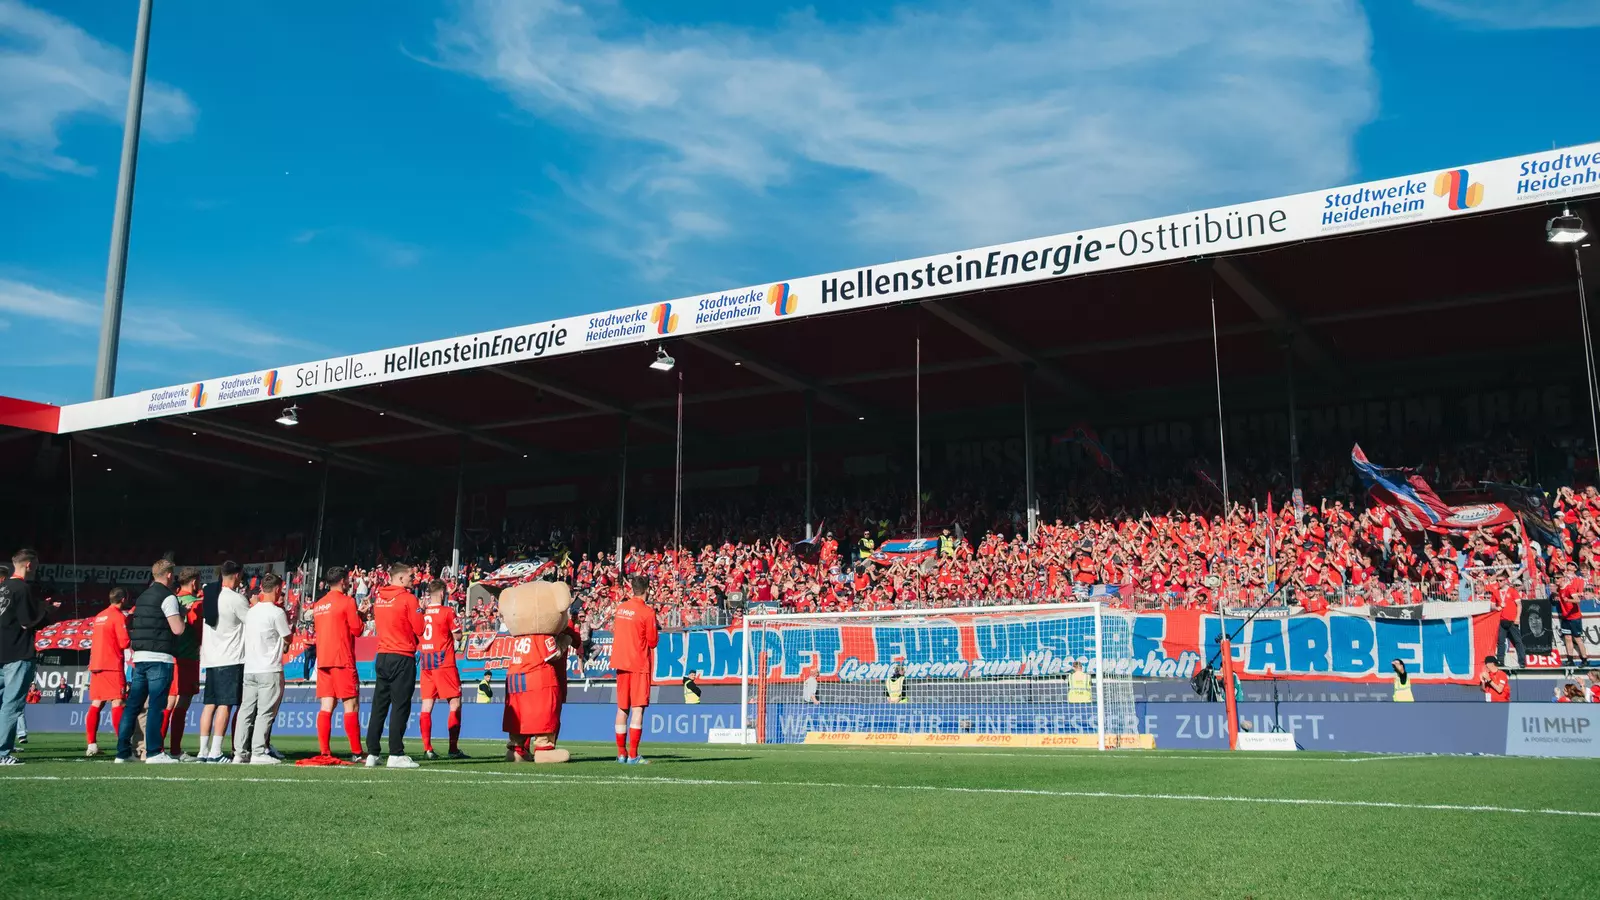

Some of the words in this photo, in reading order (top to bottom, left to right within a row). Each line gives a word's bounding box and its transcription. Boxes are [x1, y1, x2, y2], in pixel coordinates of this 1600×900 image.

[1517, 167, 1600, 194] Heidenh
[1325, 180, 1427, 210] Stadtwerke
[1322, 196, 1425, 225] Heidenheim
[821, 208, 1287, 304] HellensteinEnergie-Osttribüne
[699, 290, 764, 311] Stadtwerke
[588, 310, 648, 329] Stadtwerke
[695, 304, 761, 324] Heidenheim
[585, 323, 645, 342] Heidenheim
[296, 367, 314, 388] Sei
[324, 358, 377, 384] helle...
[384, 323, 568, 374] HellensteinEnergie
[220, 375, 262, 390] Stadtwerke
[151, 388, 189, 402] Stadtwerke
[218, 387, 260, 401] Heidenheim
[147, 399, 187, 412] Heidenheim
[1203, 614, 1474, 677] FARBEN
[971, 659, 1021, 677] zum
[986, 735, 1012, 743] LOTTO
[1052, 737, 1079, 745] LOTTO
